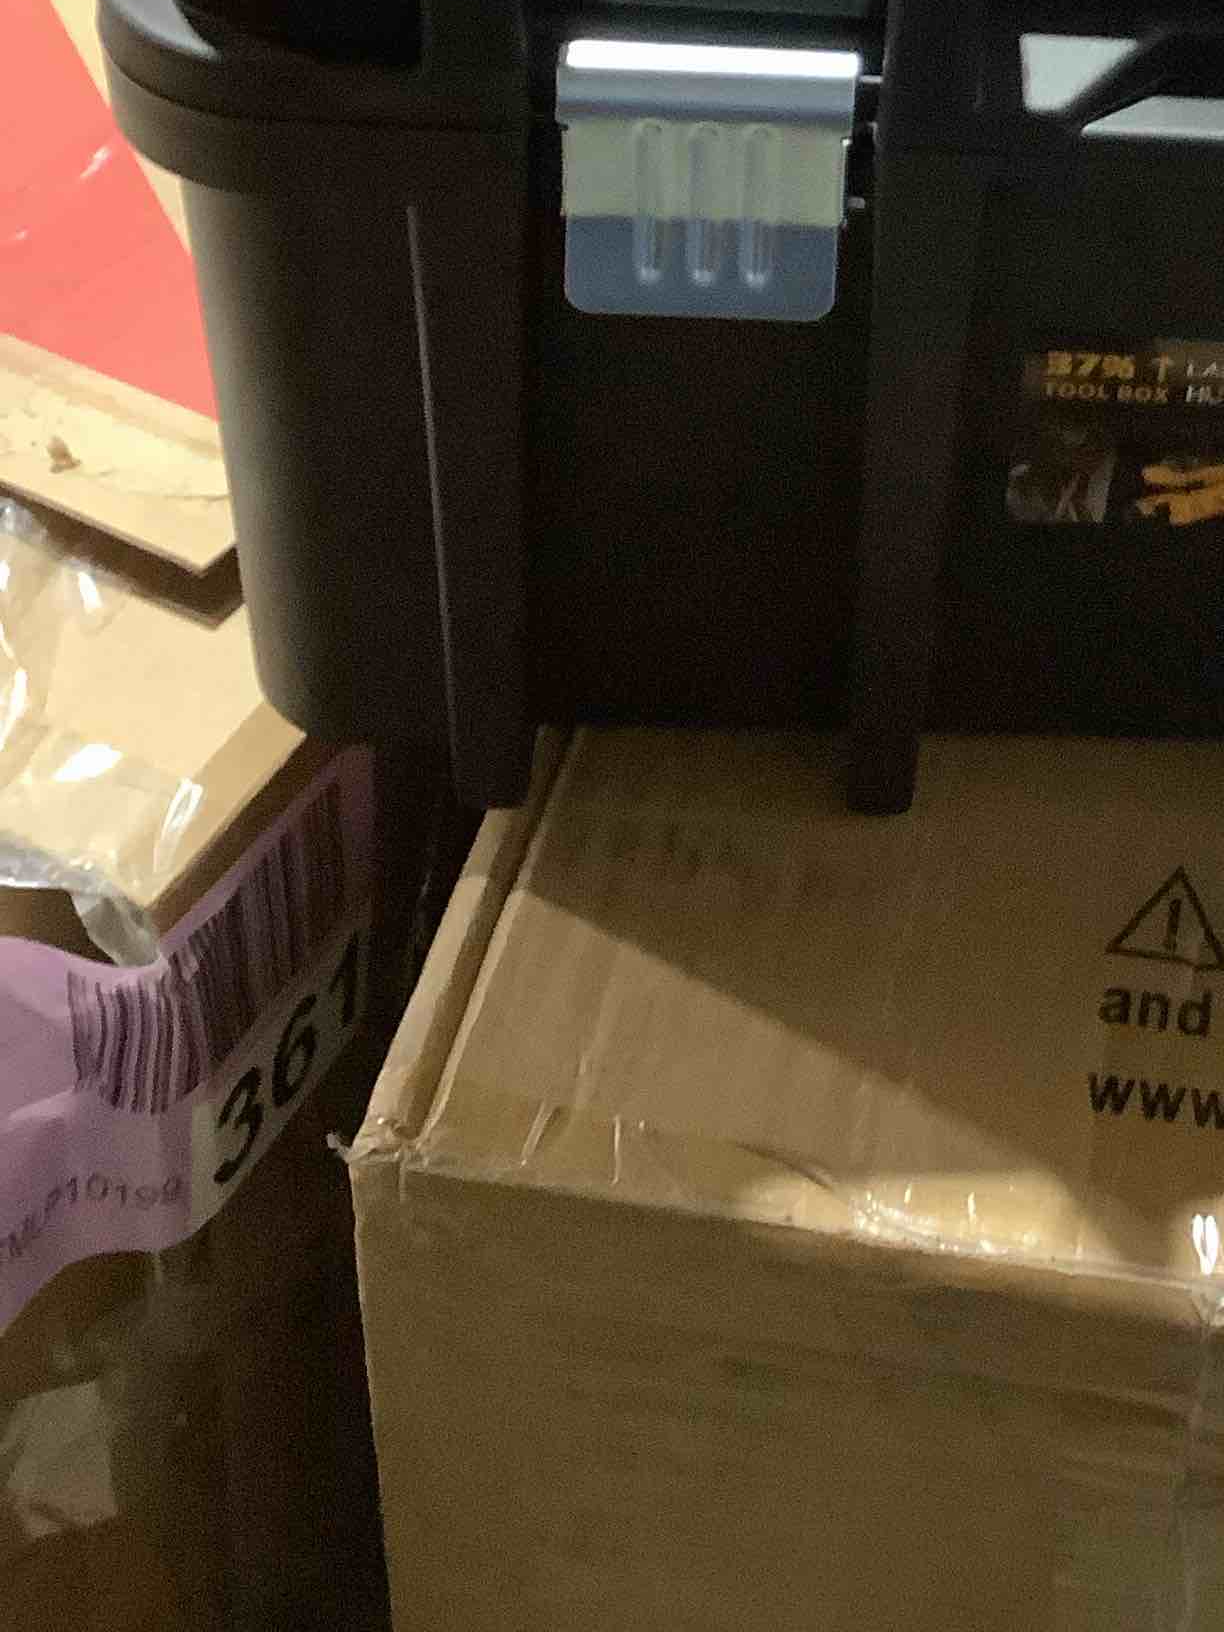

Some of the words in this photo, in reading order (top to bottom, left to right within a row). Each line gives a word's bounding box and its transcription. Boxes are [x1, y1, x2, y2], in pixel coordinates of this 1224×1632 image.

[1045, 381, 1110, 402] TOOL
[1116, 383, 1170, 405] BOX
[1098, 983, 1212, 1039] and
